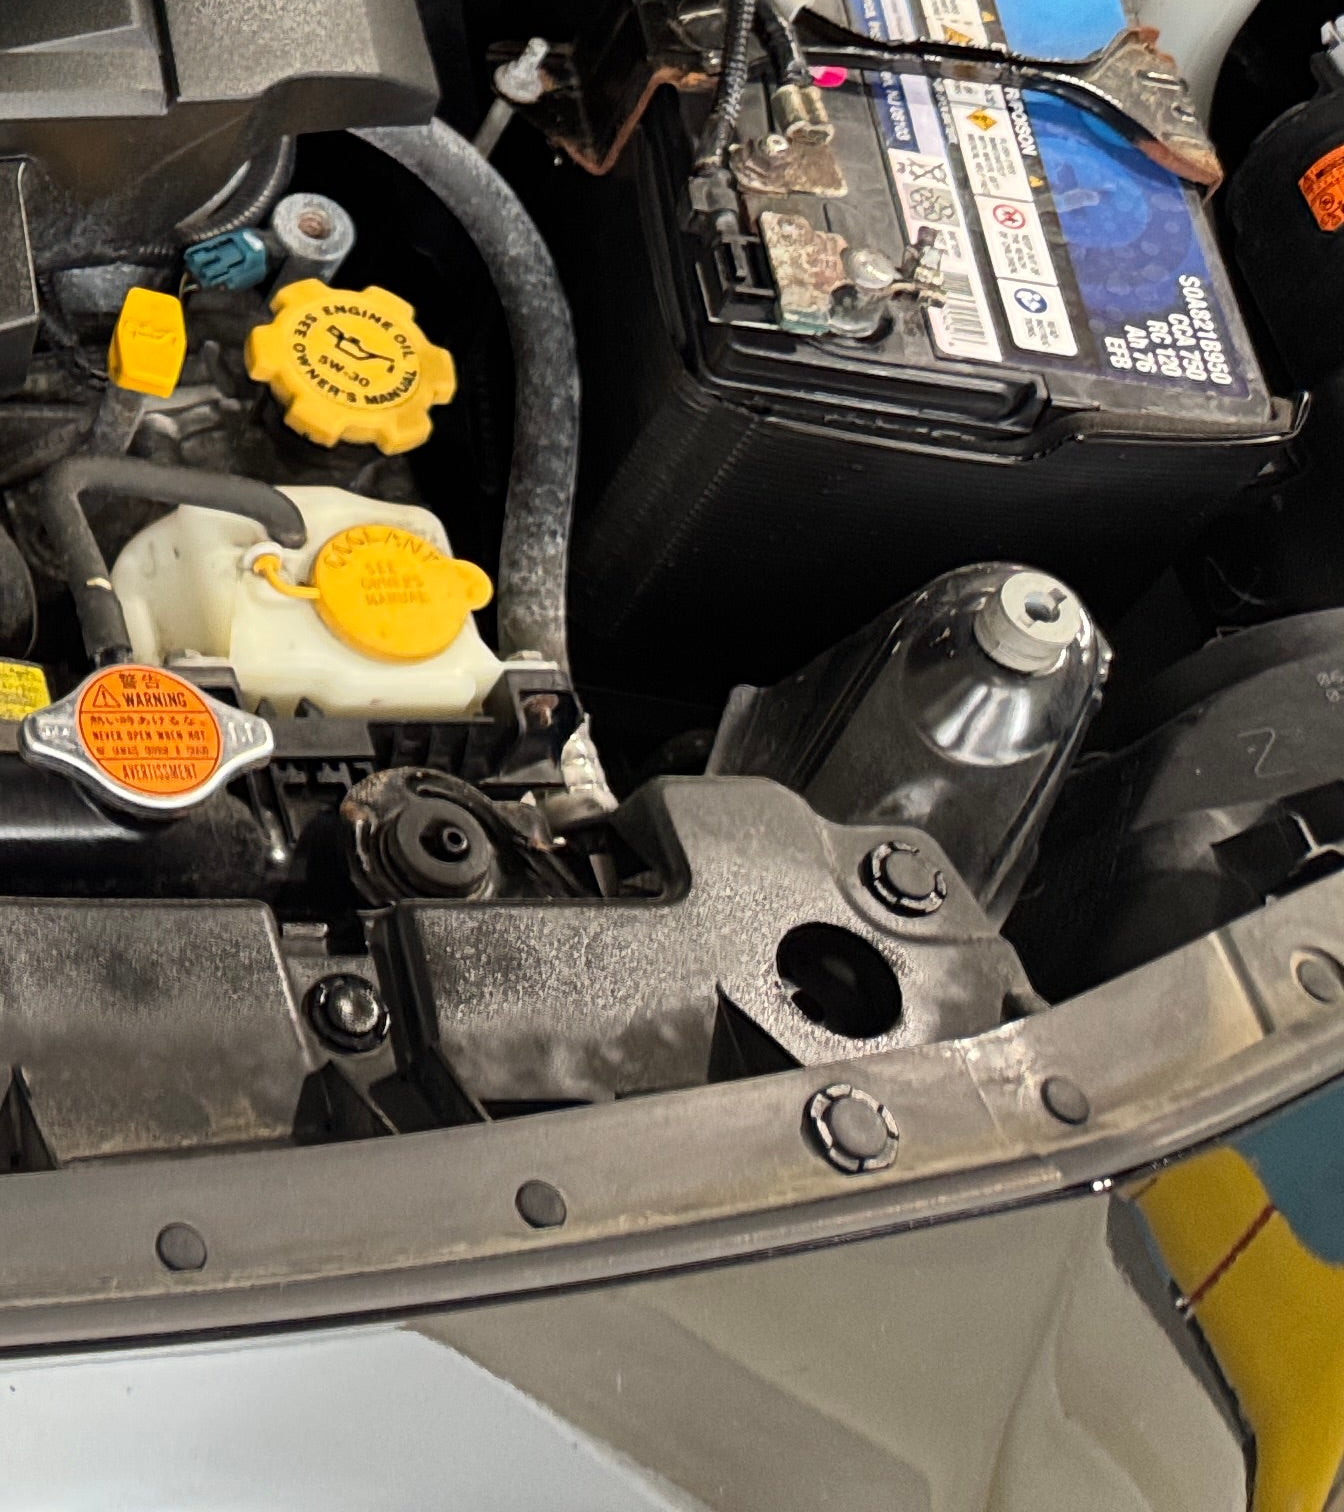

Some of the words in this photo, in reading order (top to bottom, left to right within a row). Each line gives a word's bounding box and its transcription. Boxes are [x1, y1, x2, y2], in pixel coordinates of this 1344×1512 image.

[294, 313, 318, 339] SEE
[322, 305, 393, 331] ENGINE
[394, 334, 415, 359] OIL
[1122, 325, 1150, 348] Ah
[1145, 320, 1173, 344] RC
[1166, 313, 1197, 346] CCA
[1103, 336, 1133, 369] EFB
[1131, 351, 1158, 373] 76
[1154, 347, 1183, 376] 120
[1178, 350, 1209, 380] 750
[293, 343, 357, 404] OWNER'S
[318, 355, 371, 388] 5W-30
[364, 370, 418, 406] MANUAL
[119, 673, 160, 690] 警告
[122, 692, 187, 708] WARNING
[93, 731, 123, 741] NEVER
[127, 731, 152, 741] OPEN
[157, 731, 183, 741] WHEN
[188, 731, 206, 741] HOT
